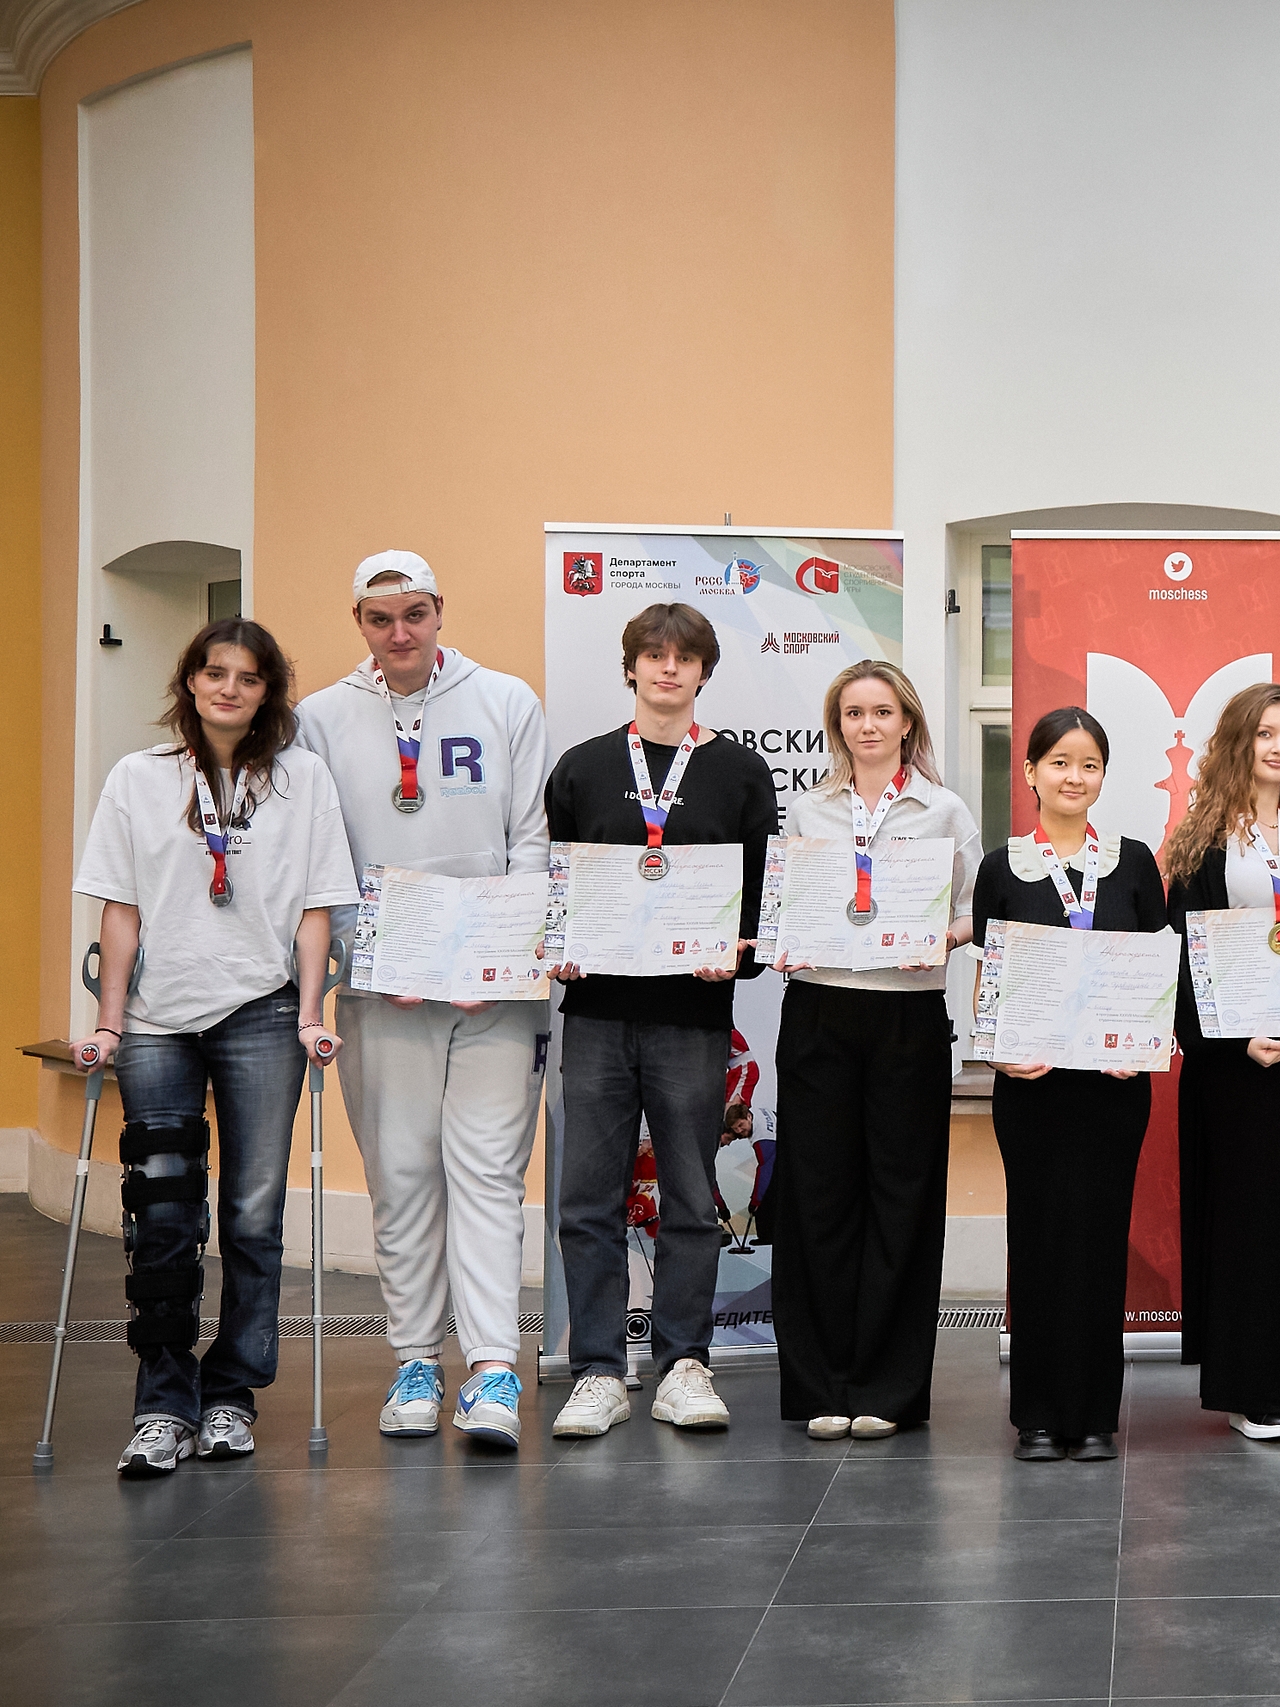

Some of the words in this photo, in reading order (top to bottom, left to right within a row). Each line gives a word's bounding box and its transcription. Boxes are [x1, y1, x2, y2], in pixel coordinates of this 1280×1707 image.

[609, 557, 677, 568] Департамент
[609, 570, 645, 579] спорта
[610, 581, 643, 589] ГОРОДА
[695, 576, 723, 586] РССС
[1149, 587, 1208, 600] moschess
[783, 630, 840, 643] МОСКОВСКИЙ
[783, 643, 810, 654] СПОРТ
[439, 735, 485, 784] R
[440, 785, 486, 797] Reebok
